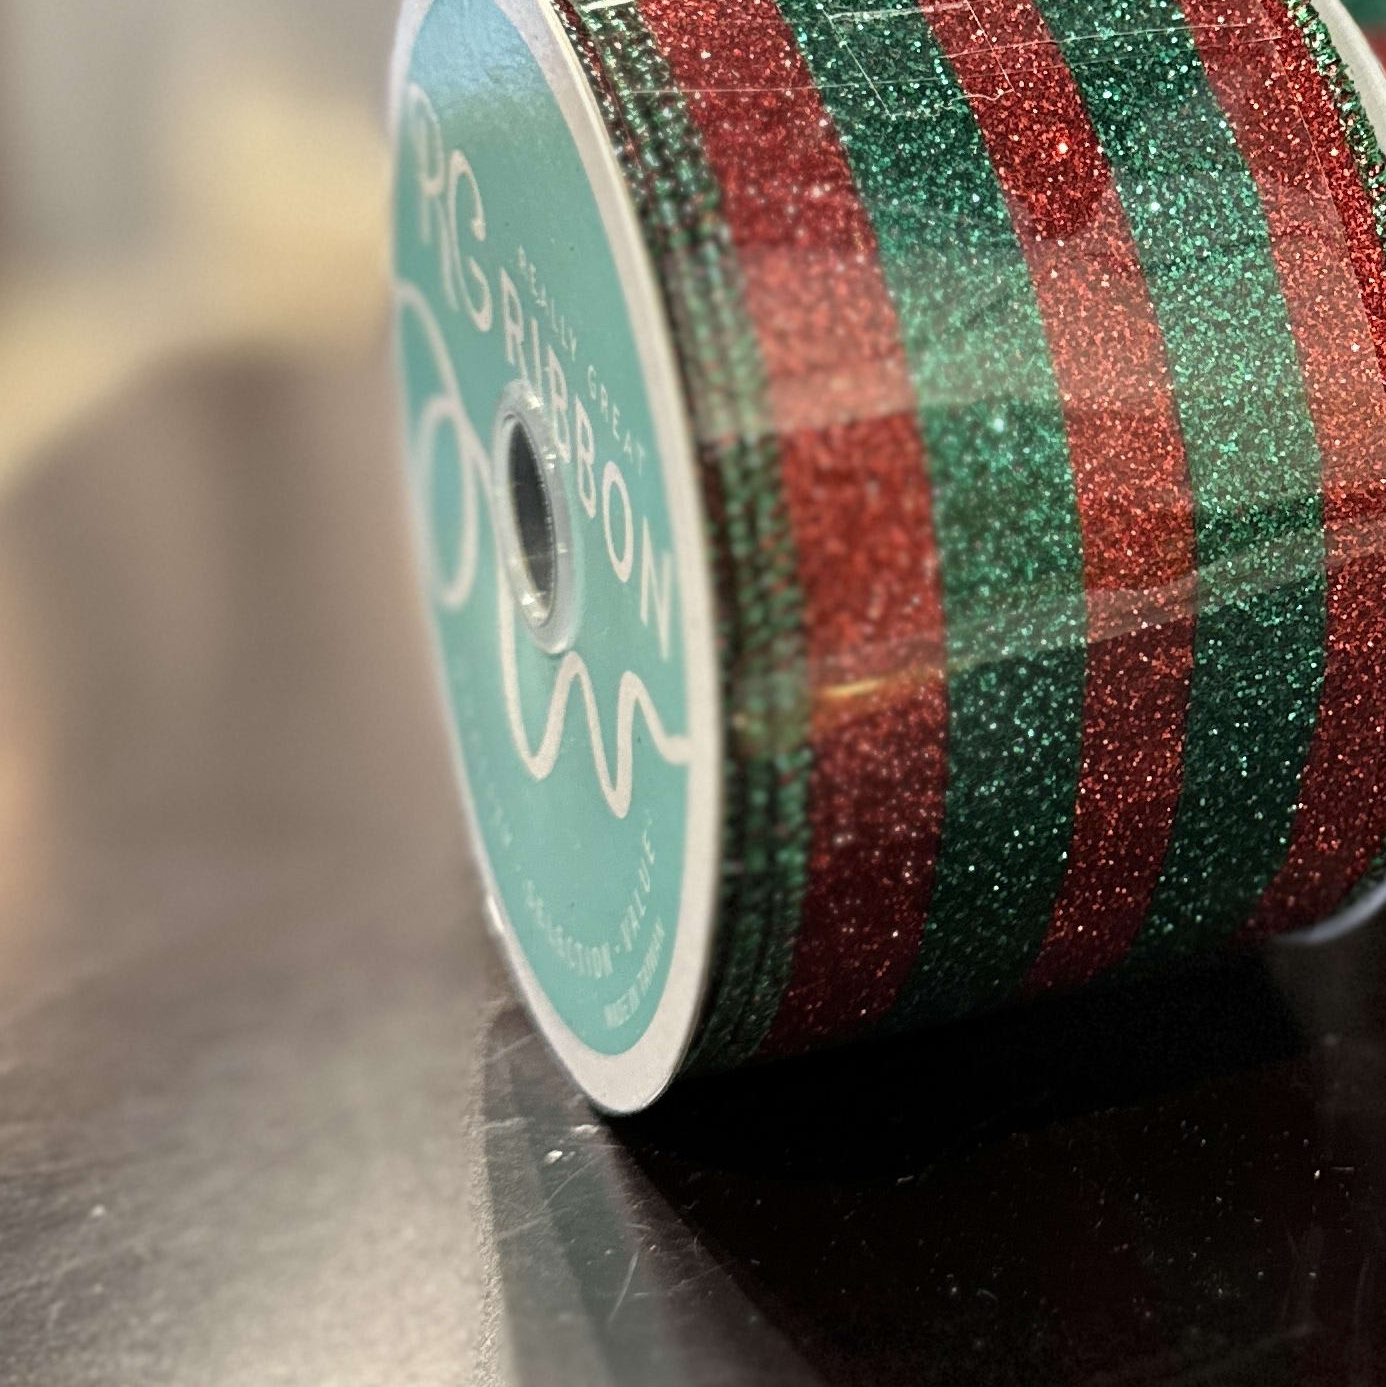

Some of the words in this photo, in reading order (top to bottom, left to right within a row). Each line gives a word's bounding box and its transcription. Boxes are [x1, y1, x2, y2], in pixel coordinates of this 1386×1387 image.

[501, 268, 672, 659] RIBBON
[517, 244, 577, 362] REALLY
[587, 364, 646, 476] GREAT
[620, 829, 655, 952] VALUE
